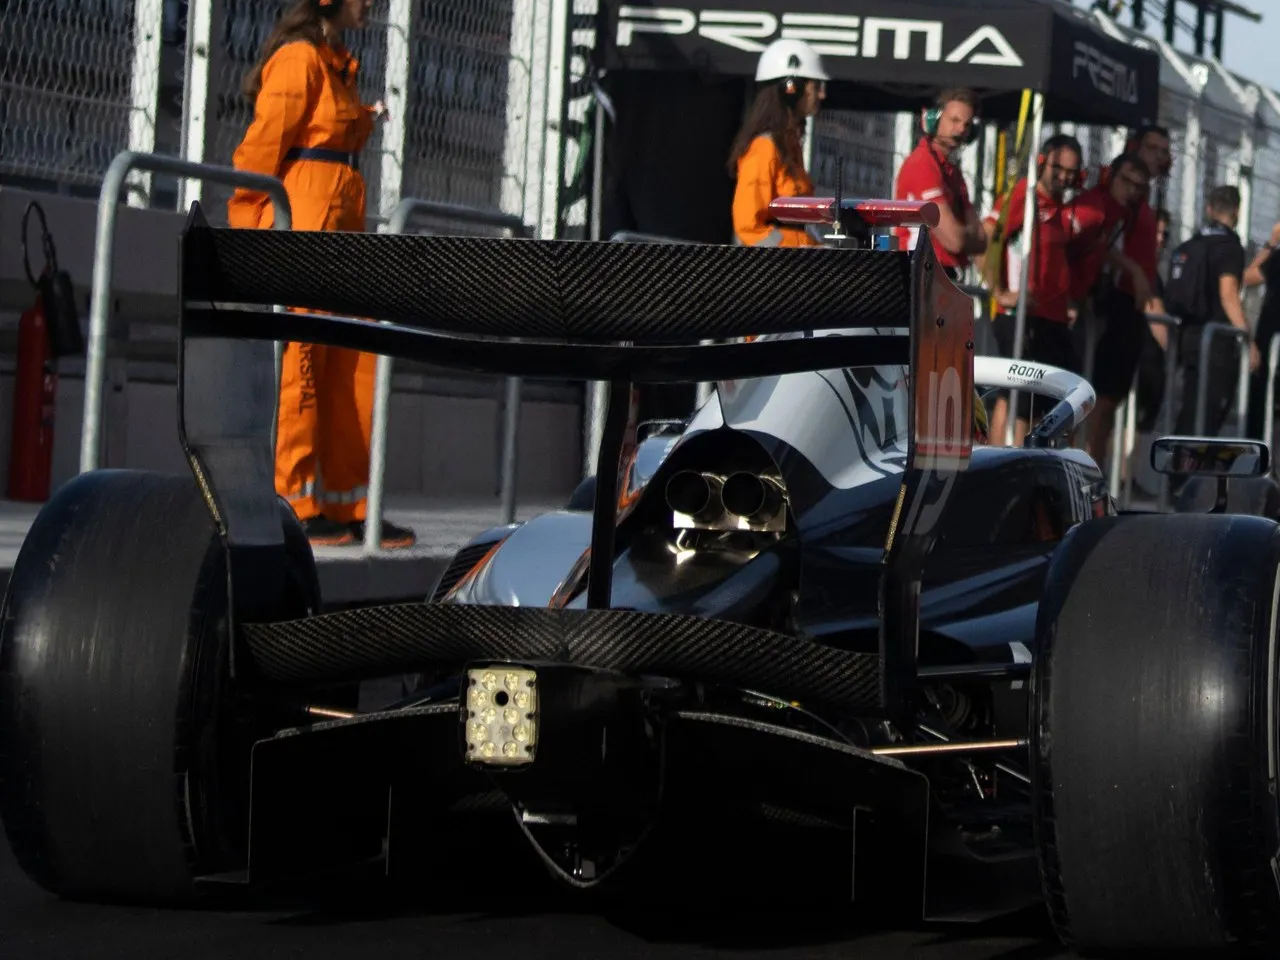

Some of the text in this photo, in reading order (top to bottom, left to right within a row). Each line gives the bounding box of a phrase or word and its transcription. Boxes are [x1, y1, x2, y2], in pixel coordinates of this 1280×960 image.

[616, 5, 1024, 67] PREMA
[1072, 41, 1138, 104] PREMA
[1007, 363, 1047, 380] RODIN
